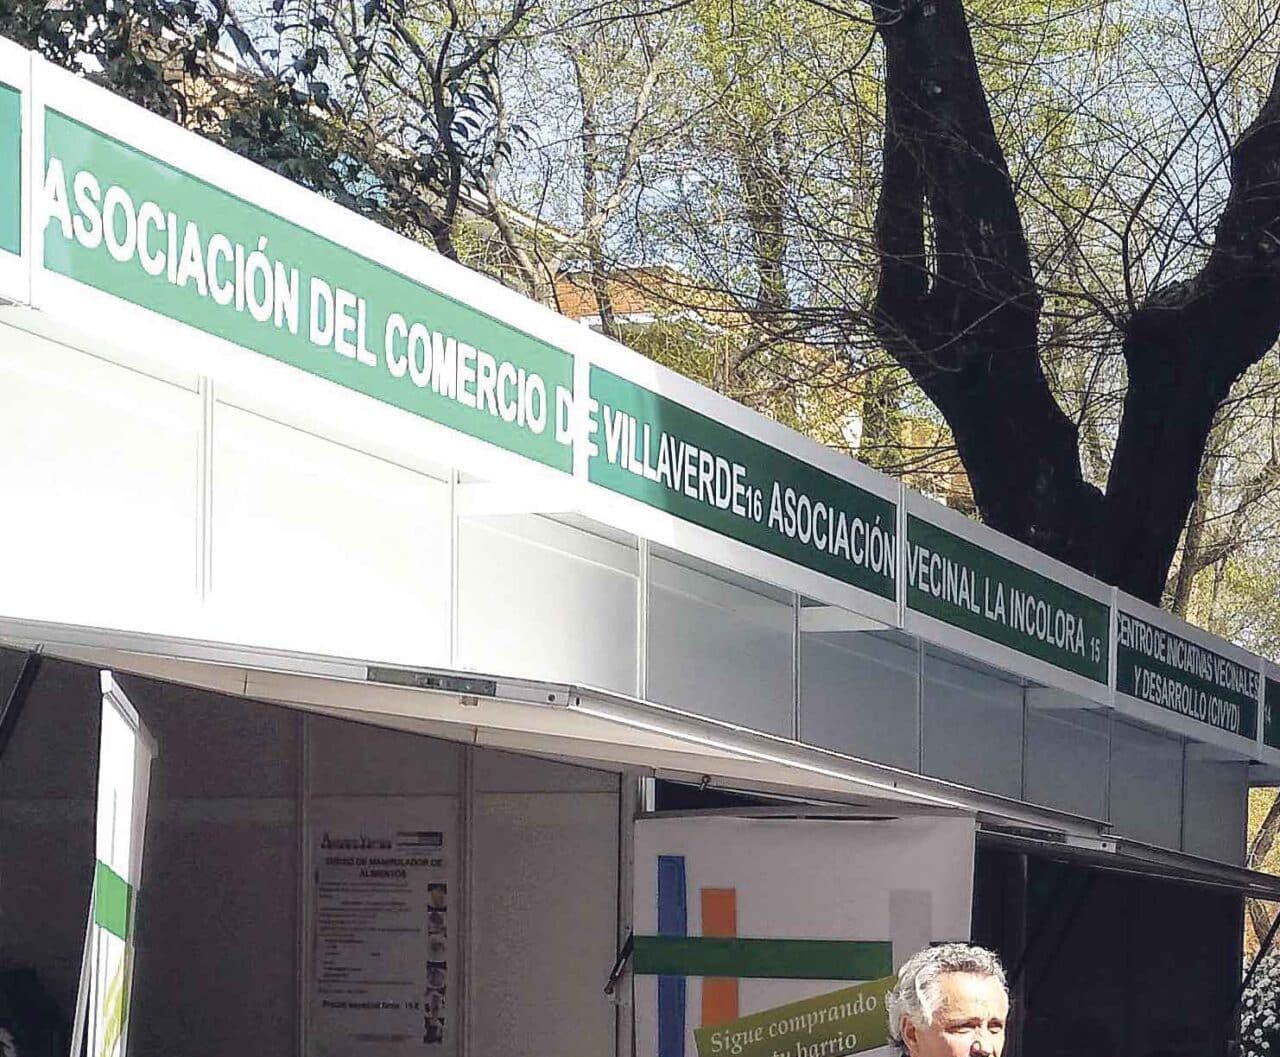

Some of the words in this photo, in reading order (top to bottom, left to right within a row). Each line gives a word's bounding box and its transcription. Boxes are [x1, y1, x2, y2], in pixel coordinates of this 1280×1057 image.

[44, 156, 299, 335] ASOCIACIÓN
[309, 276, 377, 366] DEL
[385, 313, 547, 434] COMERCIO
[554, 384, 600, 457] DE
[602, 403, 746, 518] VILLAVERDE
[746, 484, 763, 522] 16
[768, 480, 896, 579] ASOCIACIÓN
[906, 540, 980, 614] VECINAL
[984, 577, 1006, 625] LA
[1010, 587, 1085, 656] INCOLORA
[1089, 636, 1101, 663] 15
[1153, 630, 1166, 662] DE
[1213, 655, 1260, 699] VECINALES
[1134, 665, 1143, 696] Y
[1142, 669, 1206, 718] DESARROLLO
[1208, 693, 1241, 734] (CIVYD)
[710, 1027, 763, 1055] Sigue
[768, 993, 877, 1034] comprando
